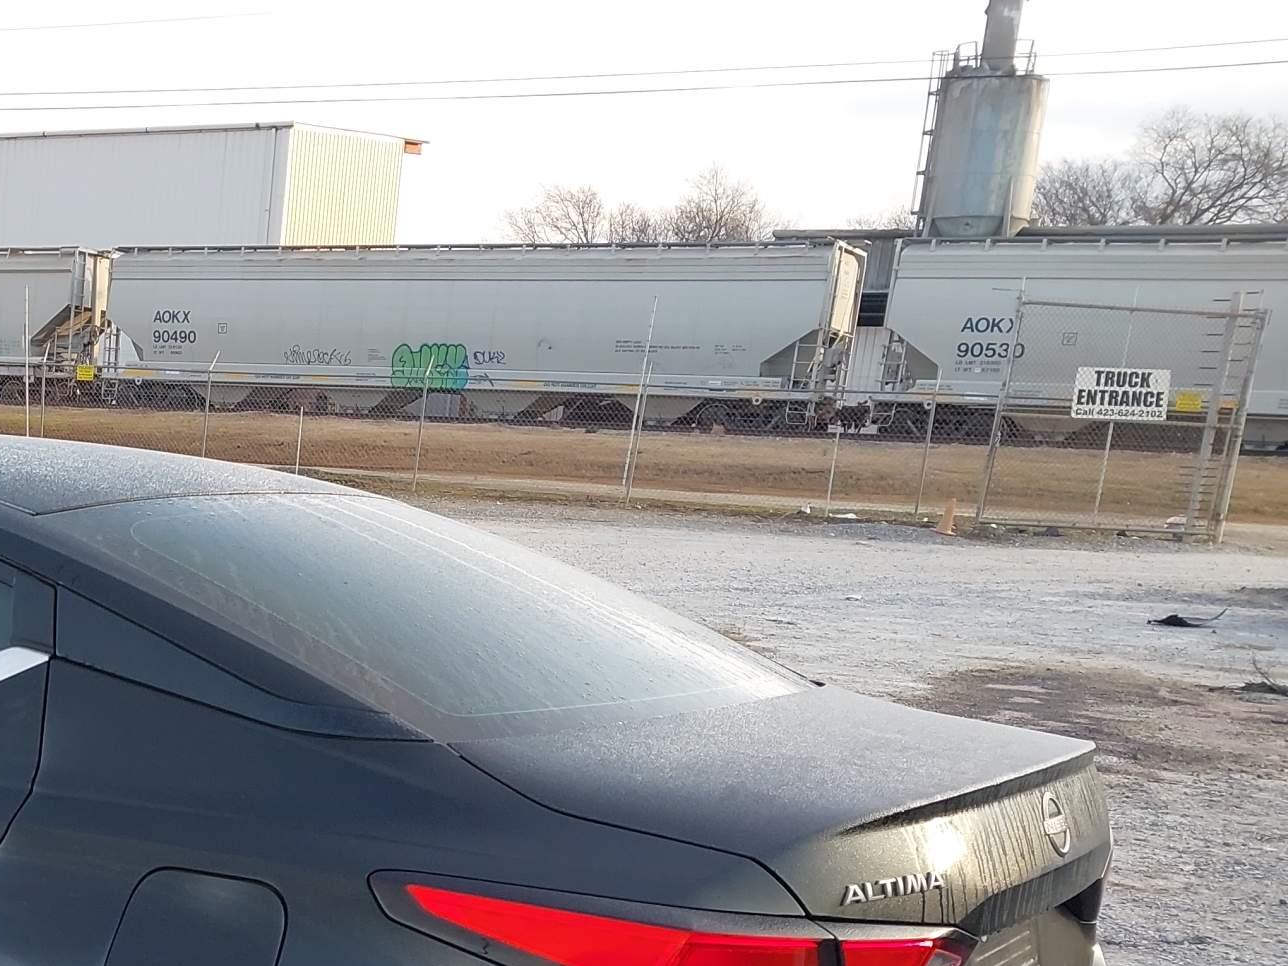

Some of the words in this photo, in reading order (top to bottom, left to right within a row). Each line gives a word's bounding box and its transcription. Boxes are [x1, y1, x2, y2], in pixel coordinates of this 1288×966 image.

[153, 310, 191, 324] AOKX
[152, 329, 197, 344] 90490
[956, 342, 1026, 359] 90530
[1094, 370, 1153, 388] TRUCK
[1076, 389, 1165, 408] ENTRANCE
[1096, 408, 1164, 418] 423-624-2102
[841, 871, 946, 906] ALTIMA
